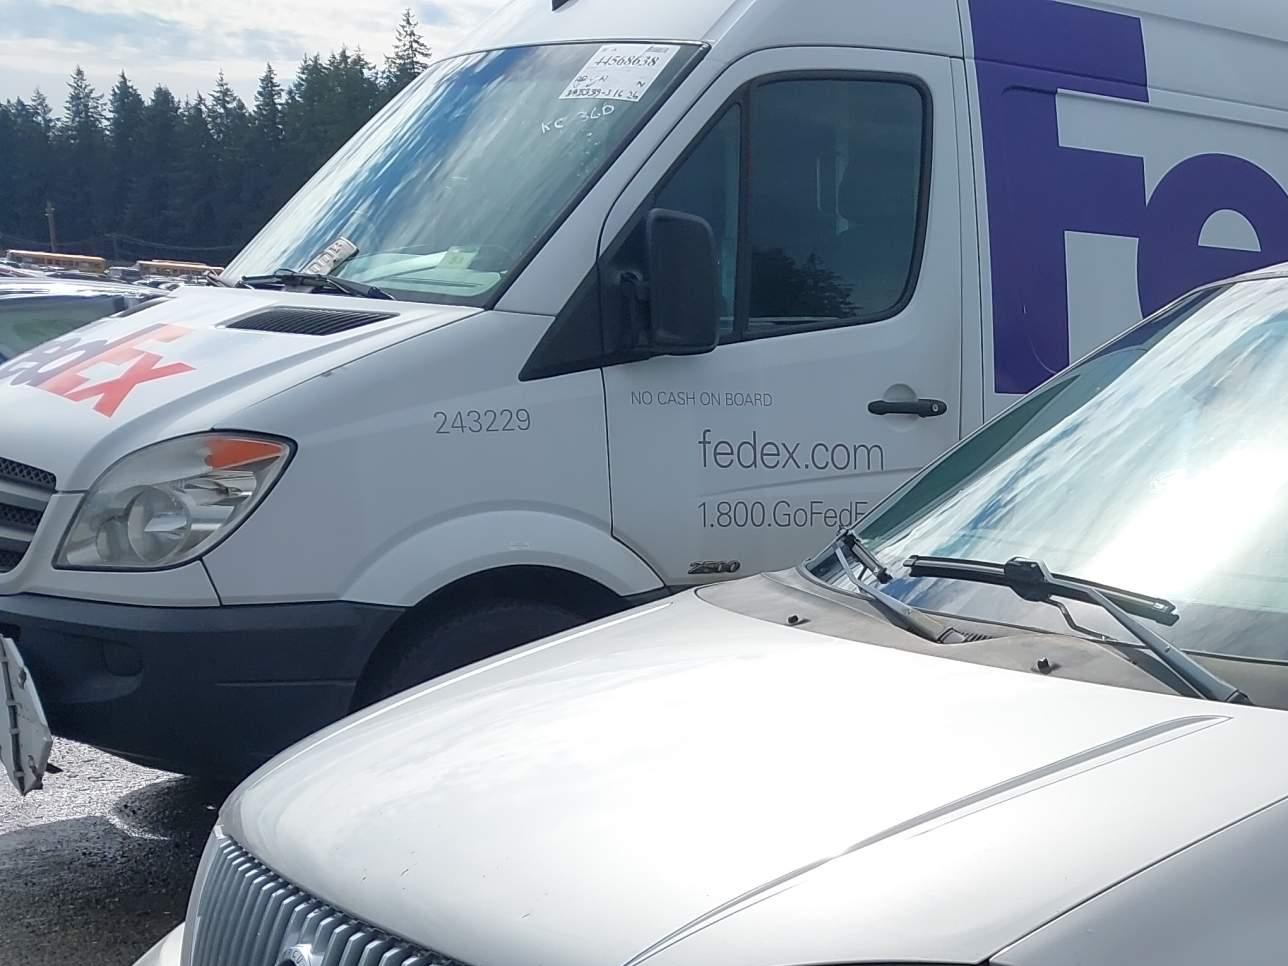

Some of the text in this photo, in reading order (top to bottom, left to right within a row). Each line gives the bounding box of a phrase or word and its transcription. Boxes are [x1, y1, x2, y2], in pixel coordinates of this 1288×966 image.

[594, 55, 660, 67] 44568638
[631, 391, 774, 408] NO CASH ON BOARD
[432, 408, 532, 434] 243229
[698, 429, 885, 471] fedex.com
[687, 559, 742, 575] 2500
